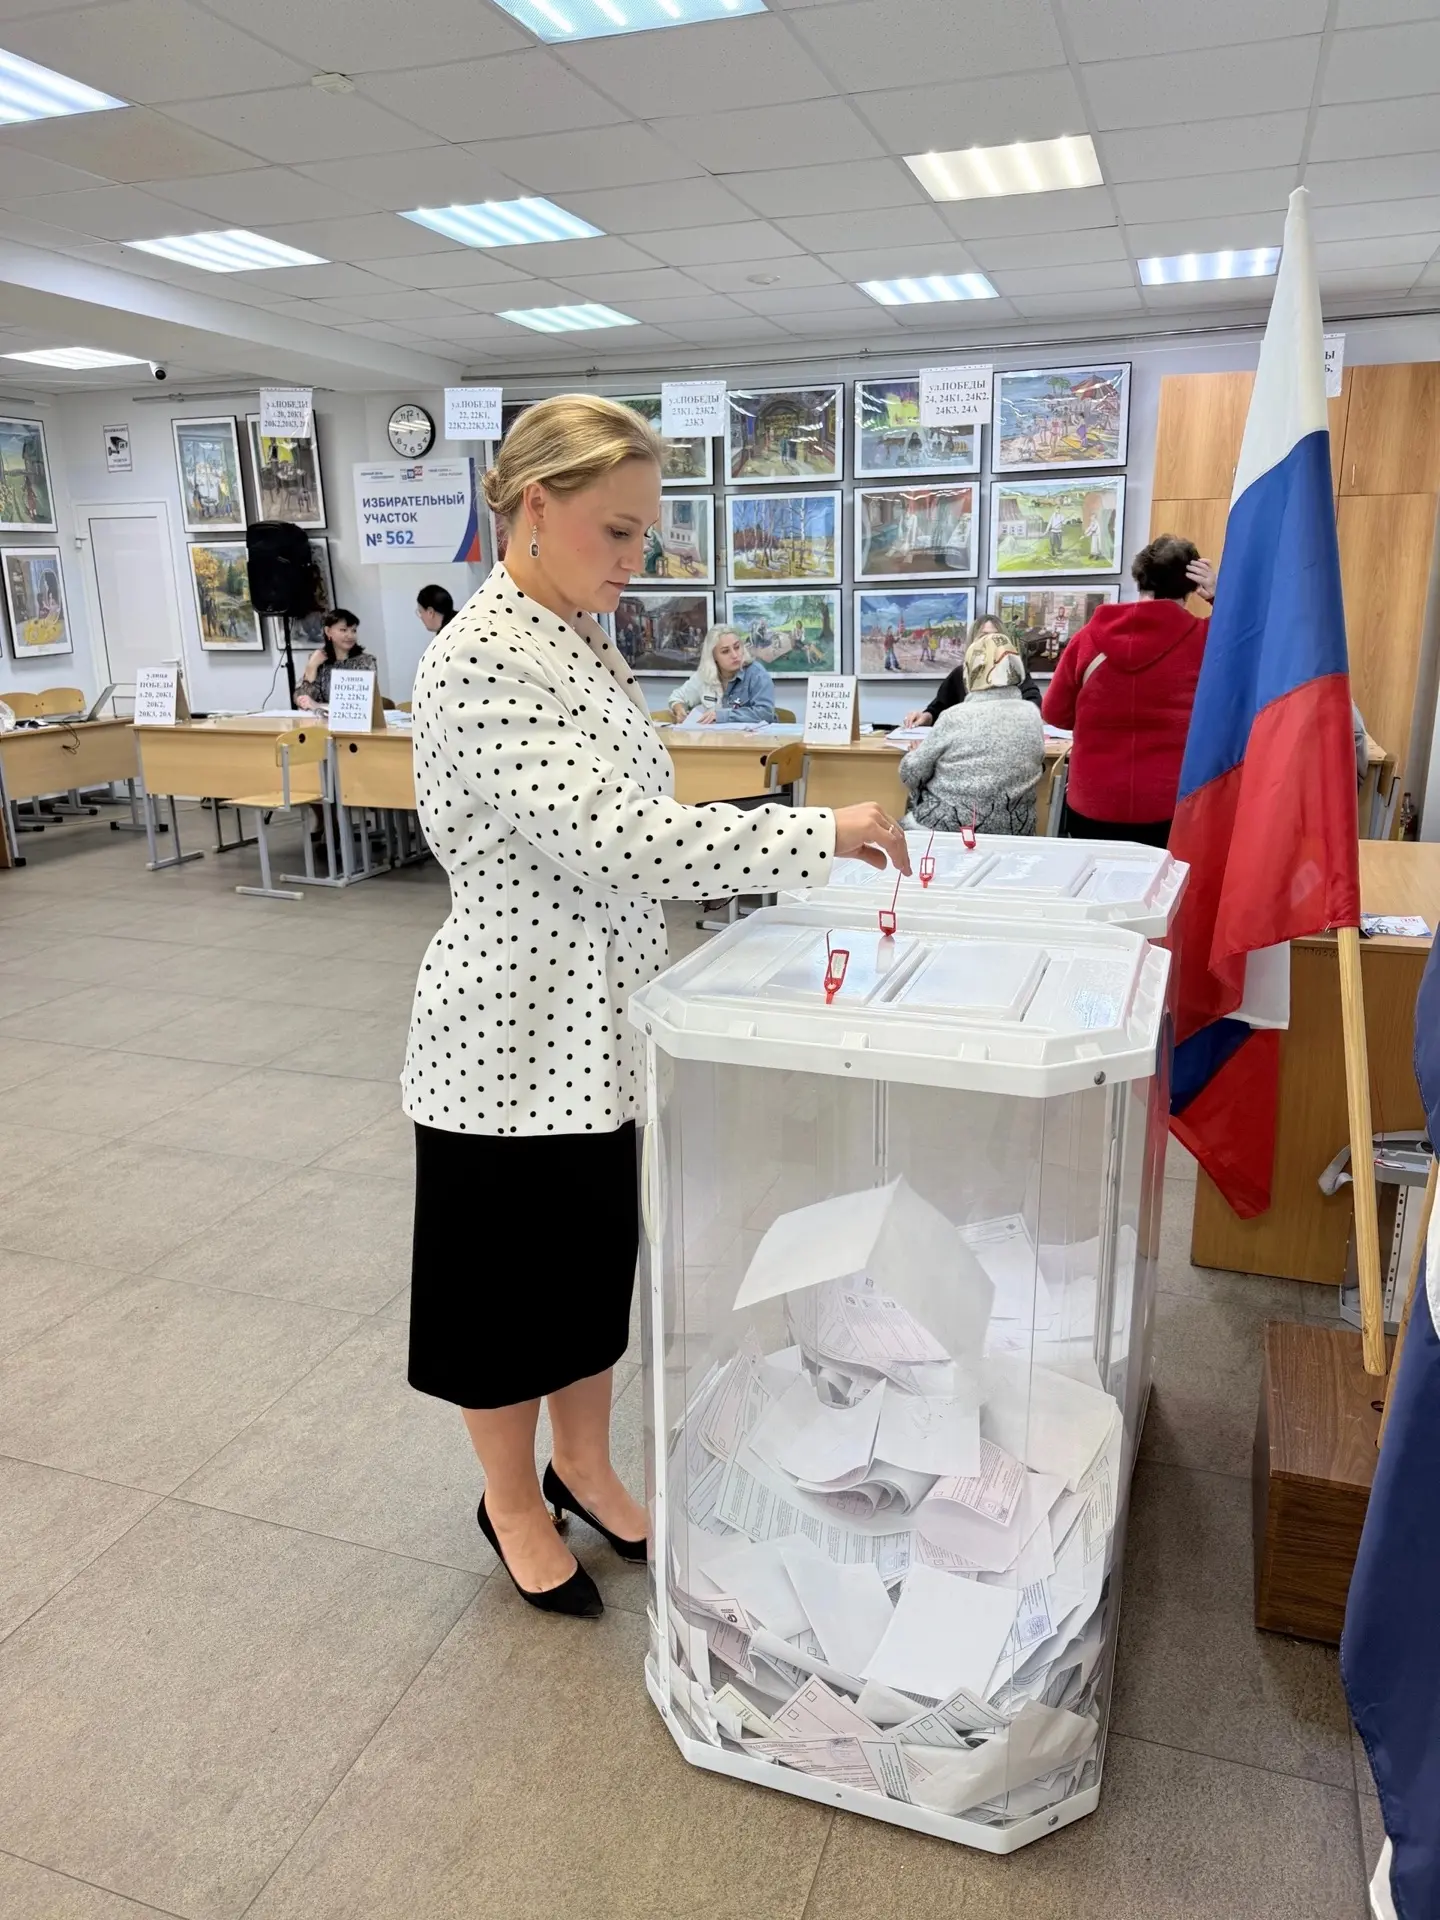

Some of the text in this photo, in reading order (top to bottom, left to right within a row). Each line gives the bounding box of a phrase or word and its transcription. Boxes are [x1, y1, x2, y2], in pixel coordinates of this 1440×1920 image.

[928, 380, 986, 393] ул.ПОБЕДЫ
[266, 401, 309, 410] ул.ПОБЕДЫ
[452, 400, 497, 410] ул.ПОБЕДЫ
[669, 395, 719, 406] ул.ПОБЕДЫ
[961, 405, 978, 414] 24А
[685, 418, 704, 426] 23К3
[362, 491, 465, 508] ИЗБИРАТЕЛЬНЫЙ
[364, 512, 418, 524] УЧАСТОК
[366, 530, 415, 546] № 562
[833, 722, 848, 730] 24А
